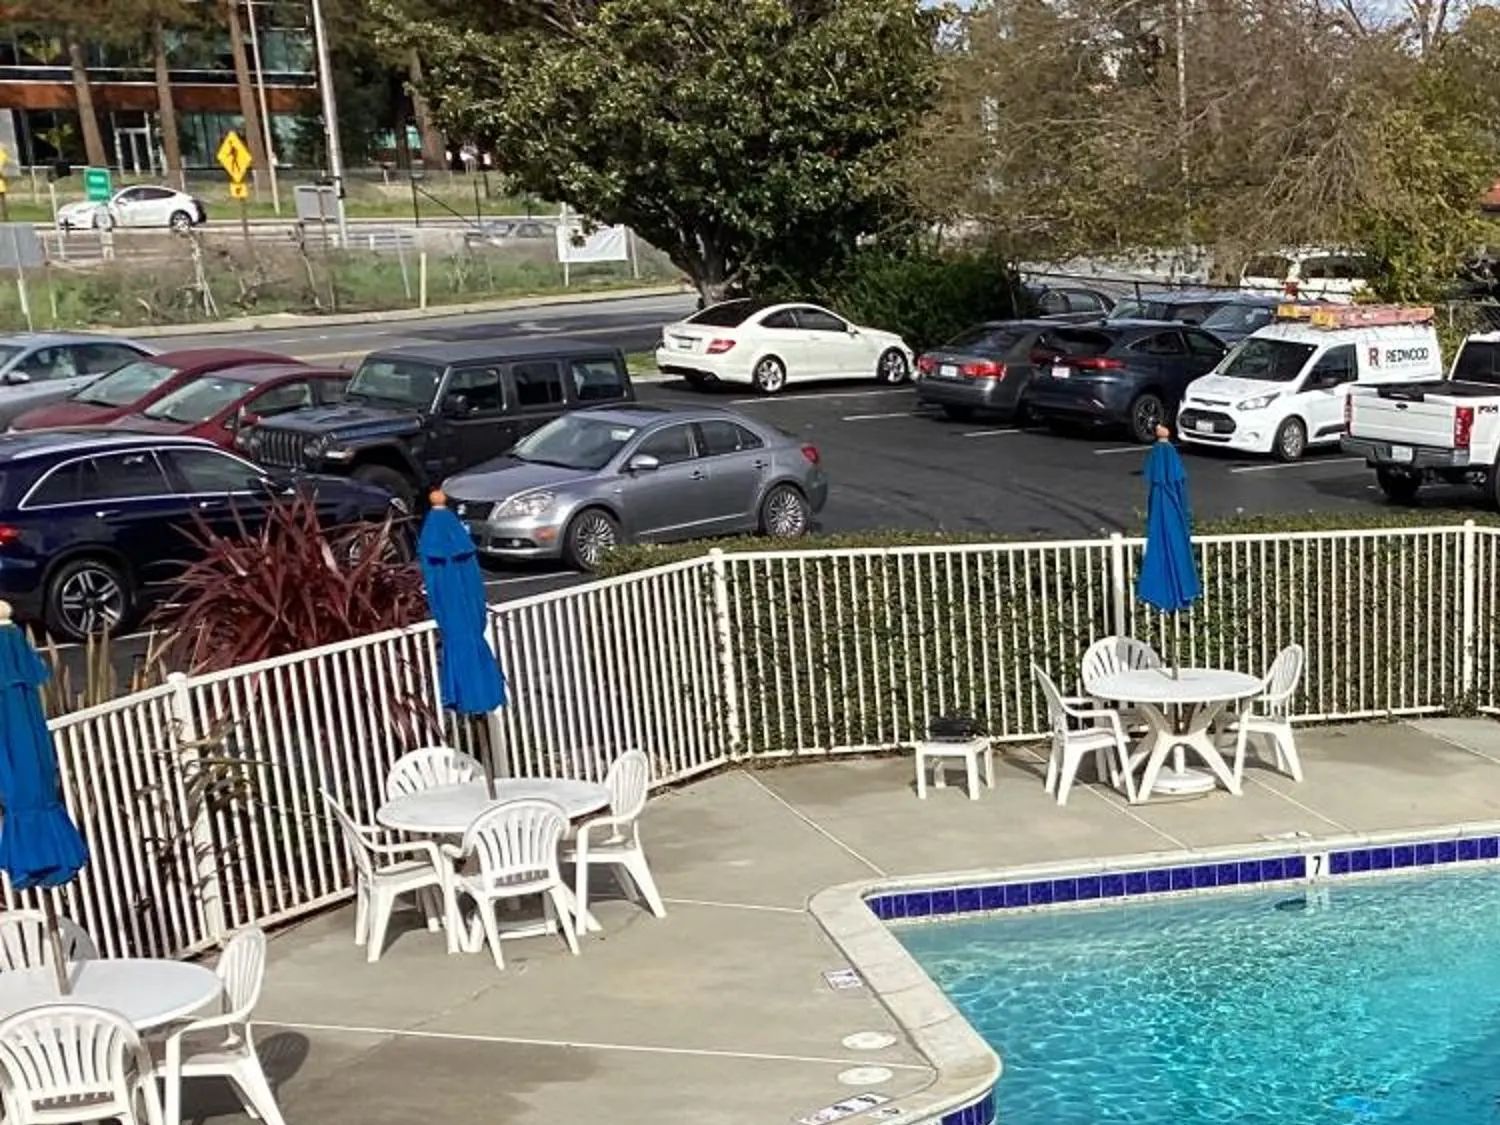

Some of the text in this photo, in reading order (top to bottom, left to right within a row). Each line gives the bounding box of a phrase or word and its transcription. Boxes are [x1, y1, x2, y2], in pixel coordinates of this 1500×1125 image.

[1369, 347, 1380, 367] R
[1385, 347, 1430, 363] REDWOOD
[1312, 855, 1322, 876] 7
